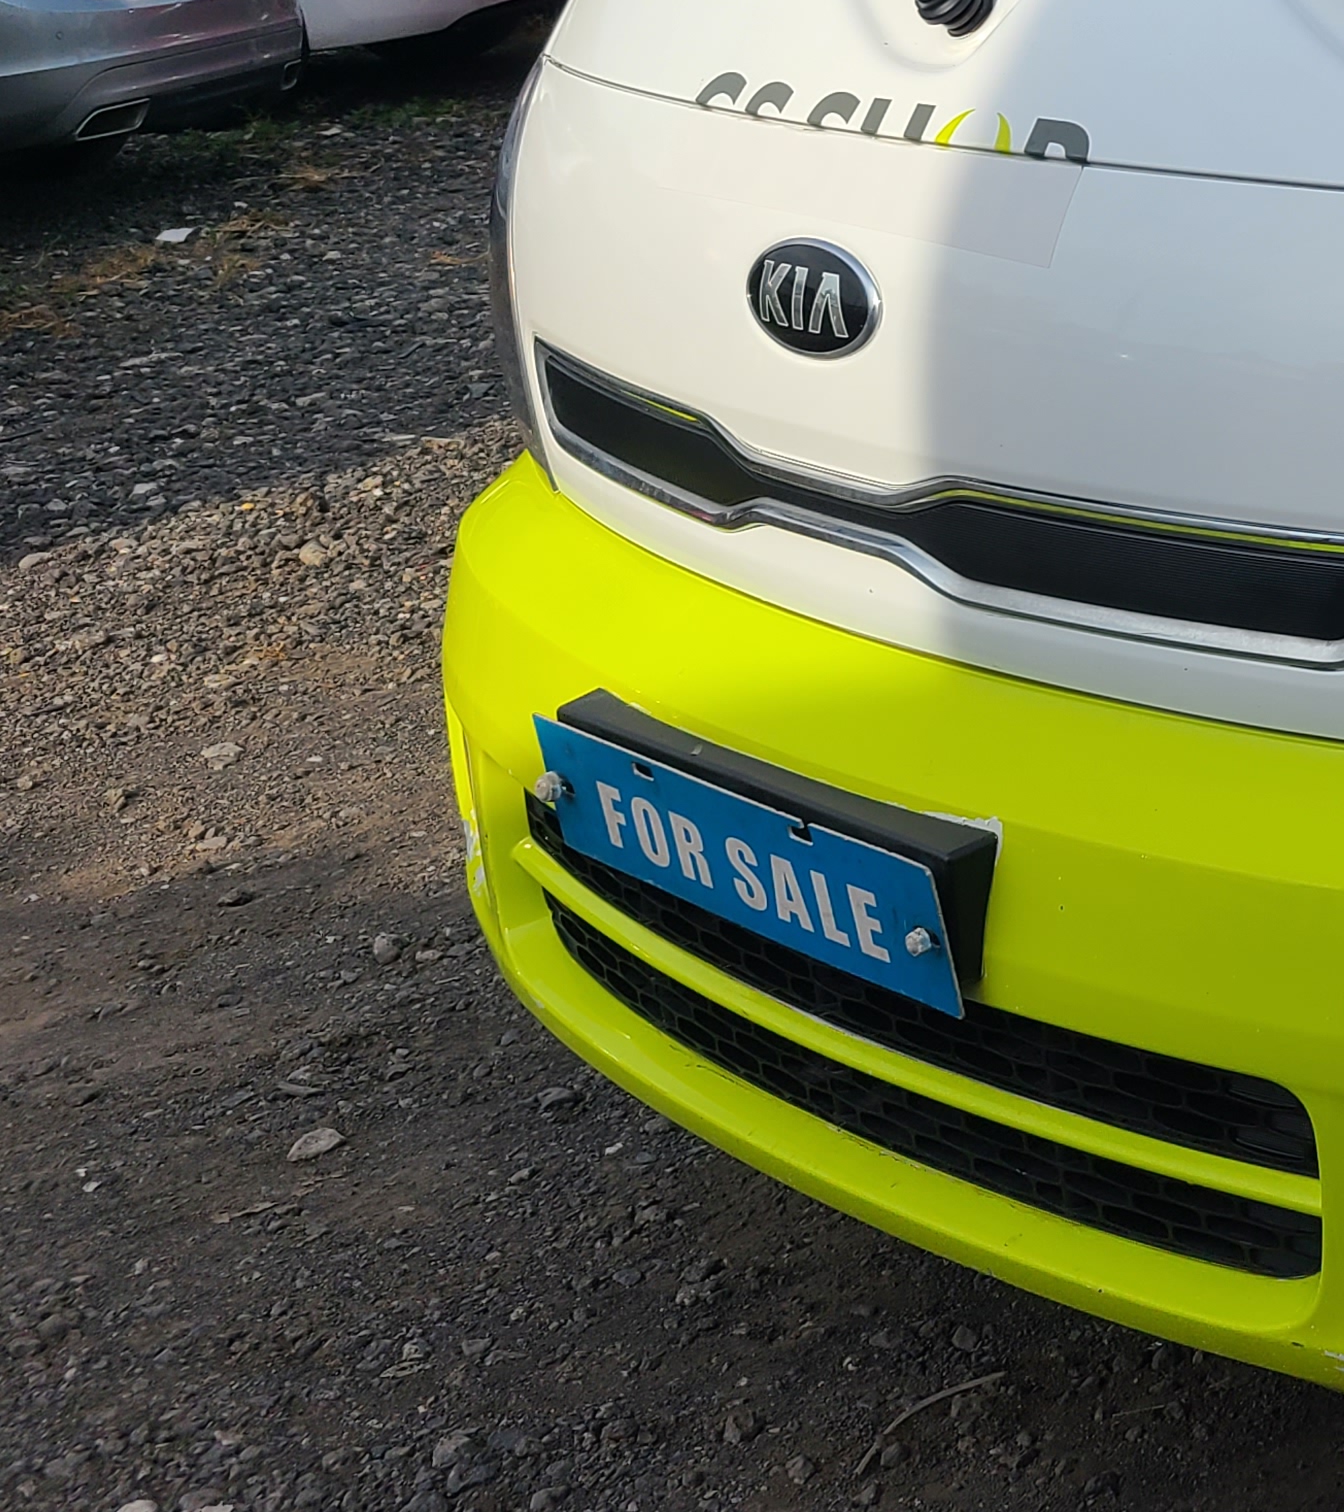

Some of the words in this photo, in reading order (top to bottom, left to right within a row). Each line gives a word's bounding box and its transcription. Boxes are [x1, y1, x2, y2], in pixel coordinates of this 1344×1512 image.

[760, 259, 850, 339] KIA
[596, 780, 714, 890] FOR
[725, 836, 893, 965] SALE
